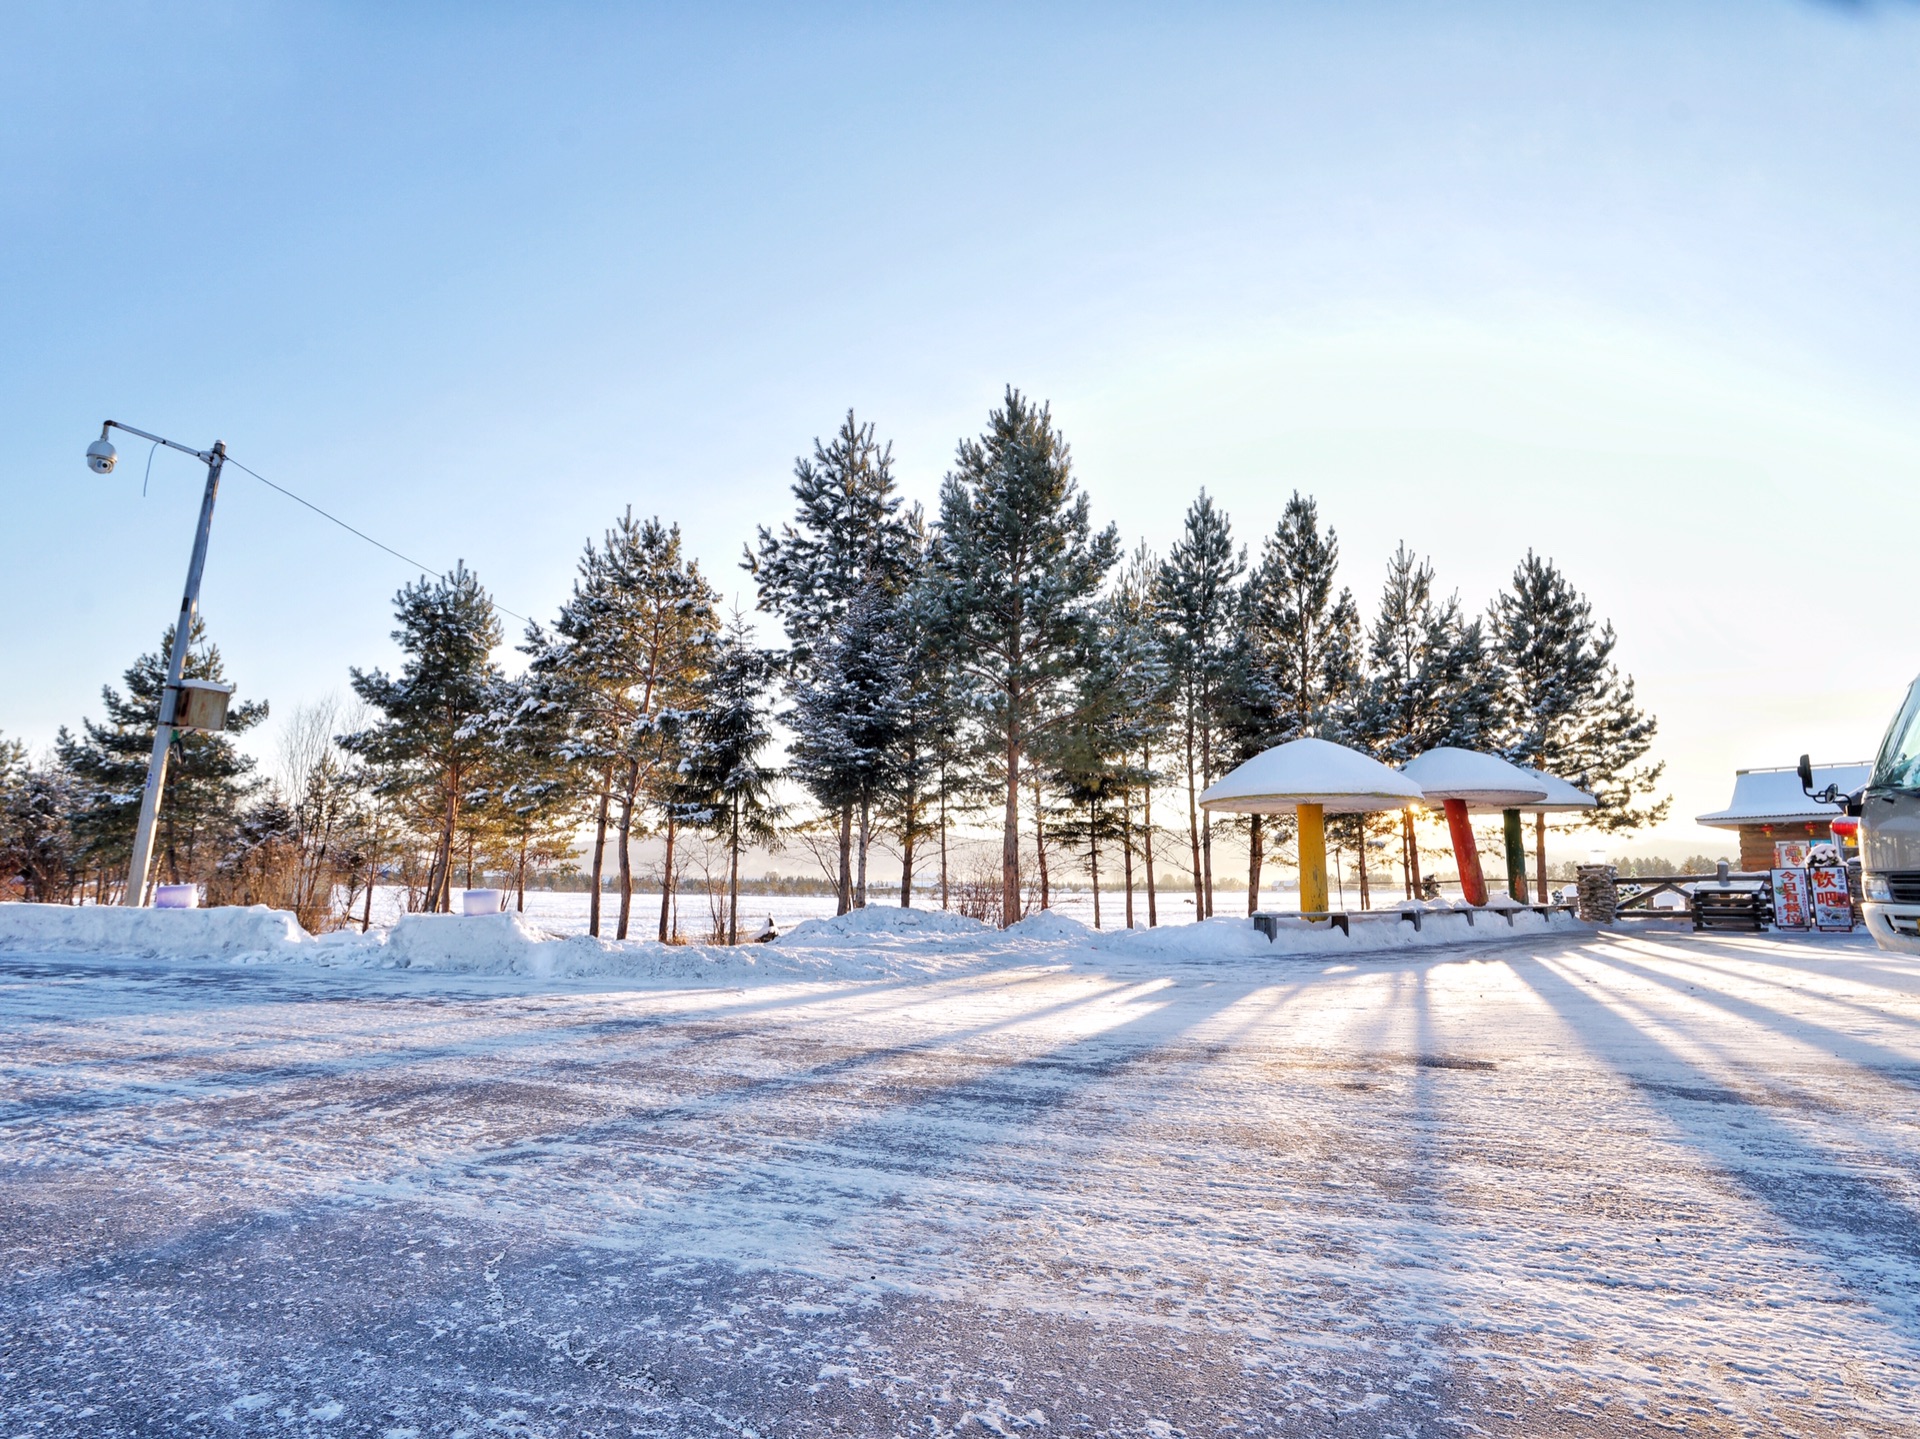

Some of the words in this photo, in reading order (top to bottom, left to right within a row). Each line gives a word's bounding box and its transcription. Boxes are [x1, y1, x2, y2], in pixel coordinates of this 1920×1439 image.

[1780, 871, 1802, 923] 今日有餐位
[1812, 871, 1838, 907] 饮吧
